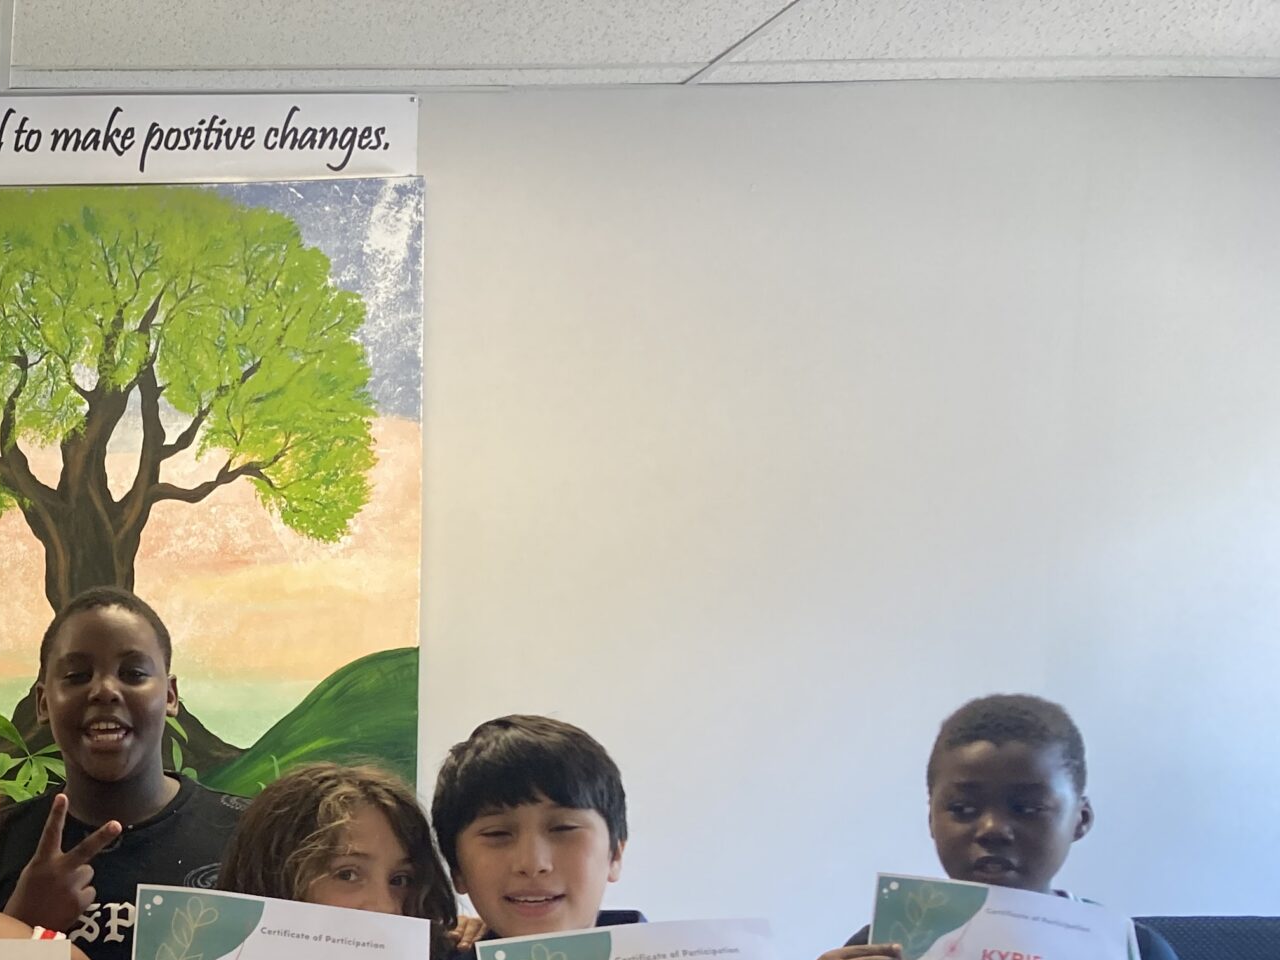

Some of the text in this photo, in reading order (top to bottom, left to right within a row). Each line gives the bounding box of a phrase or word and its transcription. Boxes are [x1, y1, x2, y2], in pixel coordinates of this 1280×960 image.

[13, 116, 43, 153] to
[51, 107, 135, 156] make
[140, 115, 255, 172] positive
[264, 106, 389, 171] changes.
[260, 927, 310, 940] Certificate
[325, 935, 385, 949] Participation
[670, 950, 679, 958] of
